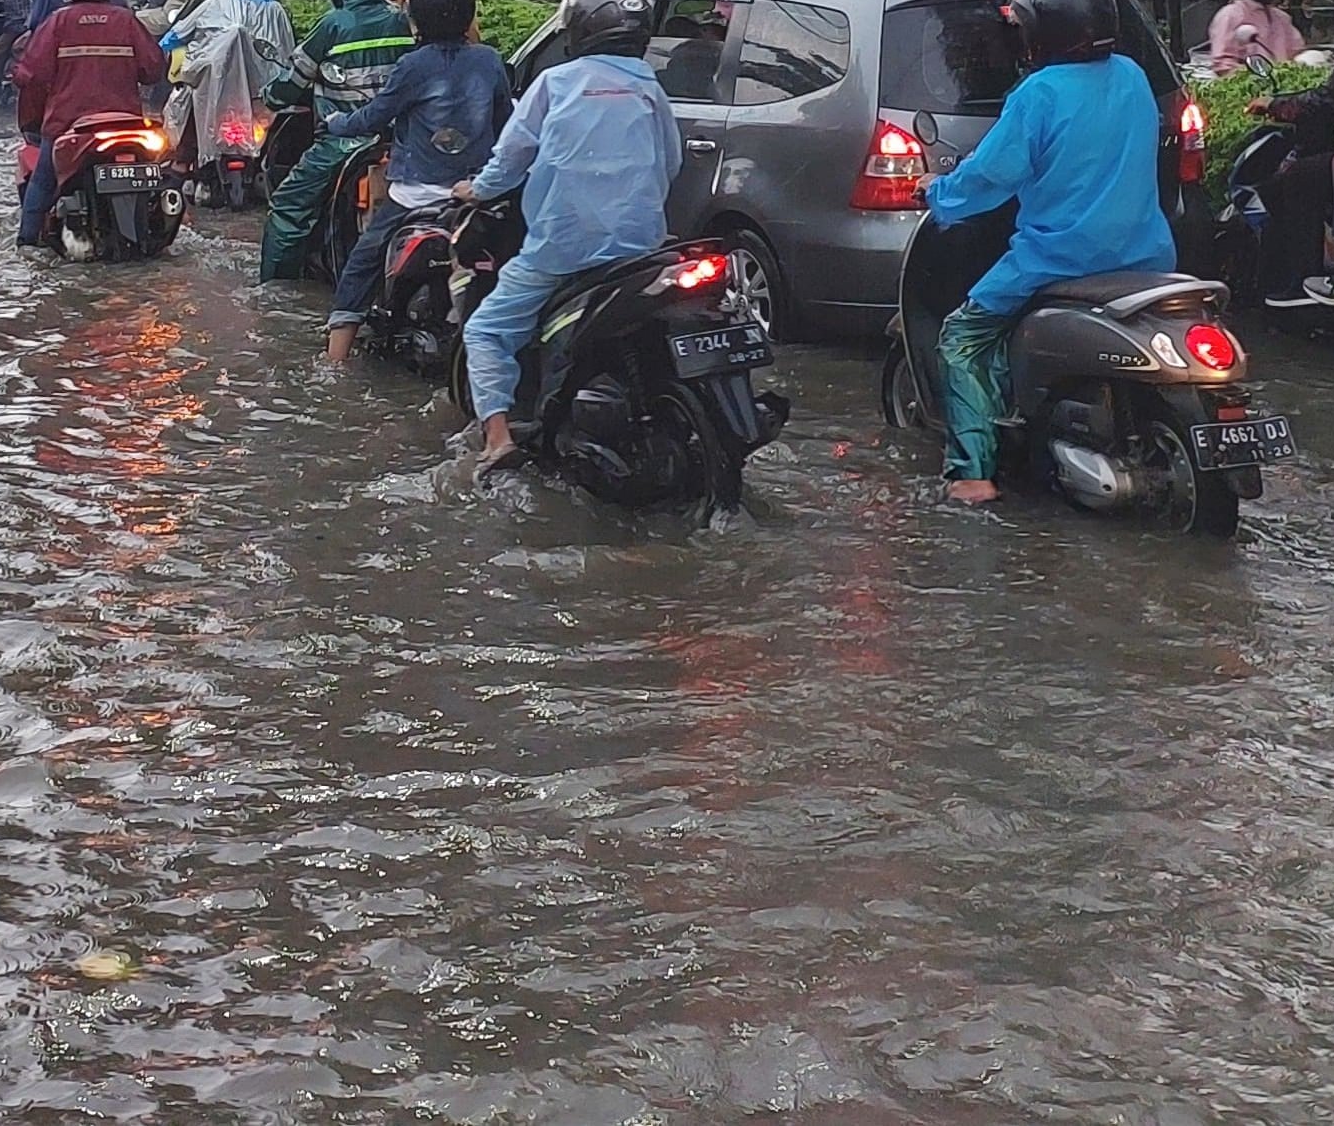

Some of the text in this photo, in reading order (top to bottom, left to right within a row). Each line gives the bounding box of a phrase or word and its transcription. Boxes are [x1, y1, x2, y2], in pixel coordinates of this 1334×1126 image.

[99, 169, 107, 179] E
[676, 340, 689, 356] E
[695, 334, 730, 353] 2344
[1196, 421, 1287, 448] E 4662 DJ
